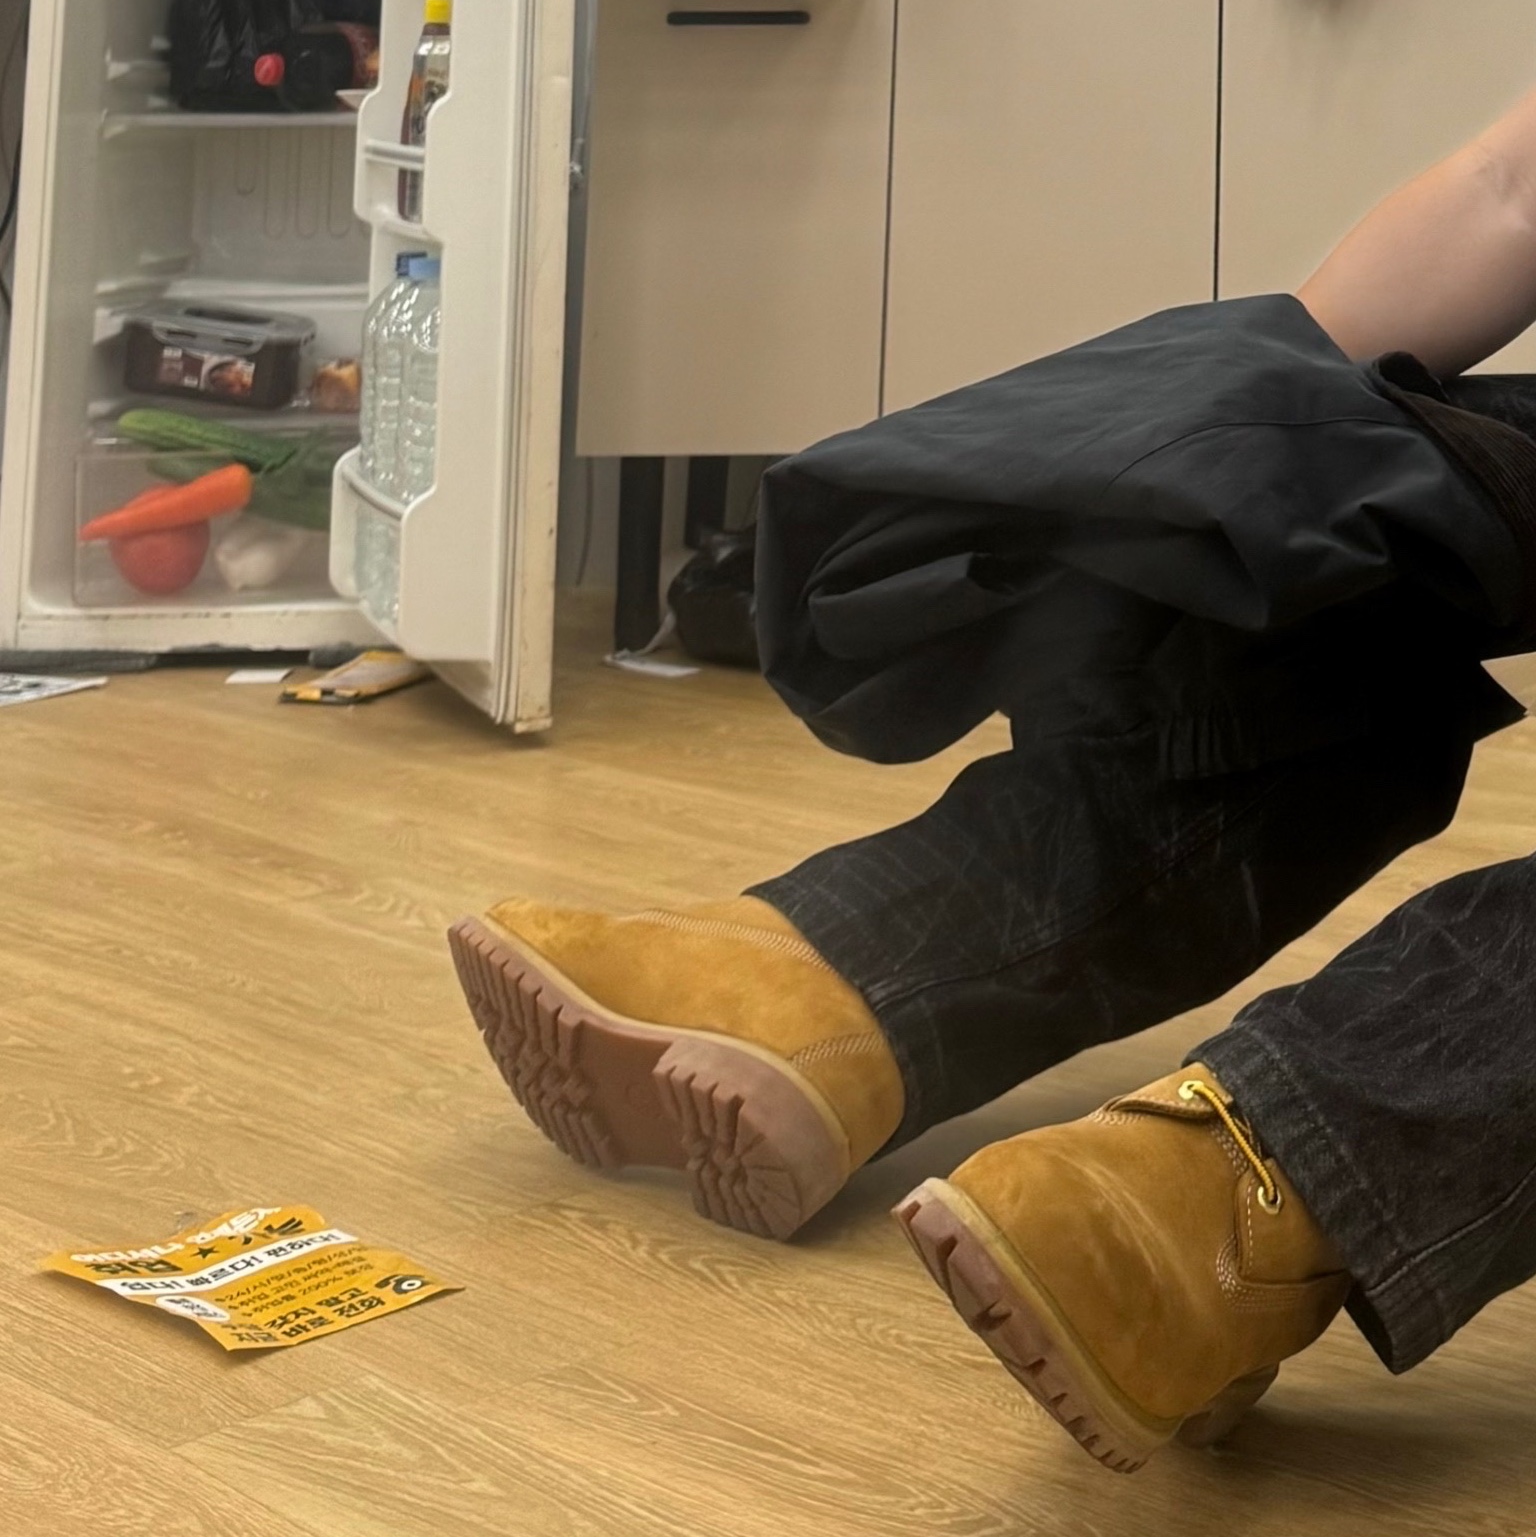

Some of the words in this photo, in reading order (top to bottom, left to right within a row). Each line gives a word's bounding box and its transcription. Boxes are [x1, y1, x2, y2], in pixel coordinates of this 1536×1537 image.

[186, 1256, 263, 1286] 빠르다!
[263, 1232, 341, 1258] 편하다!
[281, 1316, 335, 1338] 바로
[332, 1296, 386, 1318] 전화
